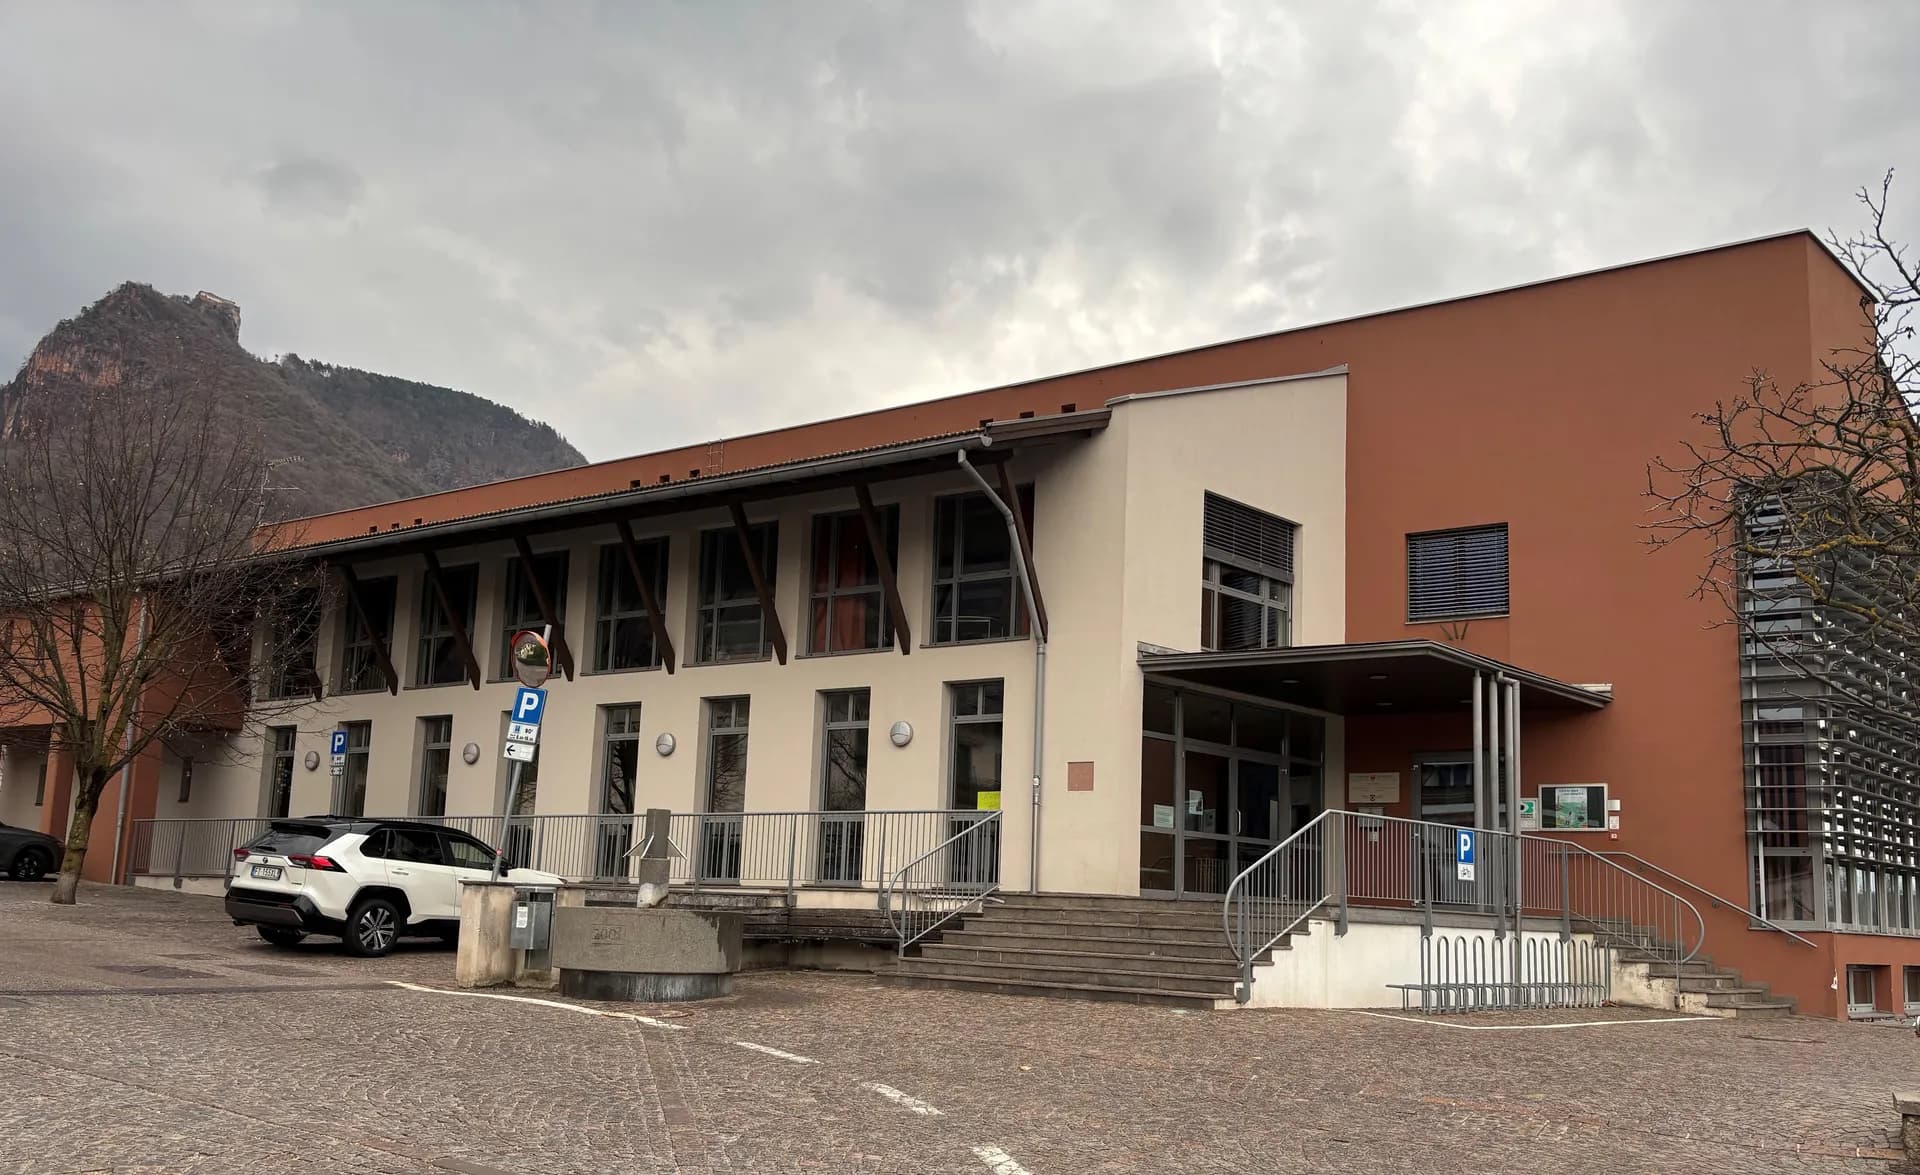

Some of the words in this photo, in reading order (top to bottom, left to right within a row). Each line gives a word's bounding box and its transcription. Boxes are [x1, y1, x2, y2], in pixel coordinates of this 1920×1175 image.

[519, 692, 539, 719] P
[334, 734, 344, 752] P
[1460, 833, 1471, 860] P
